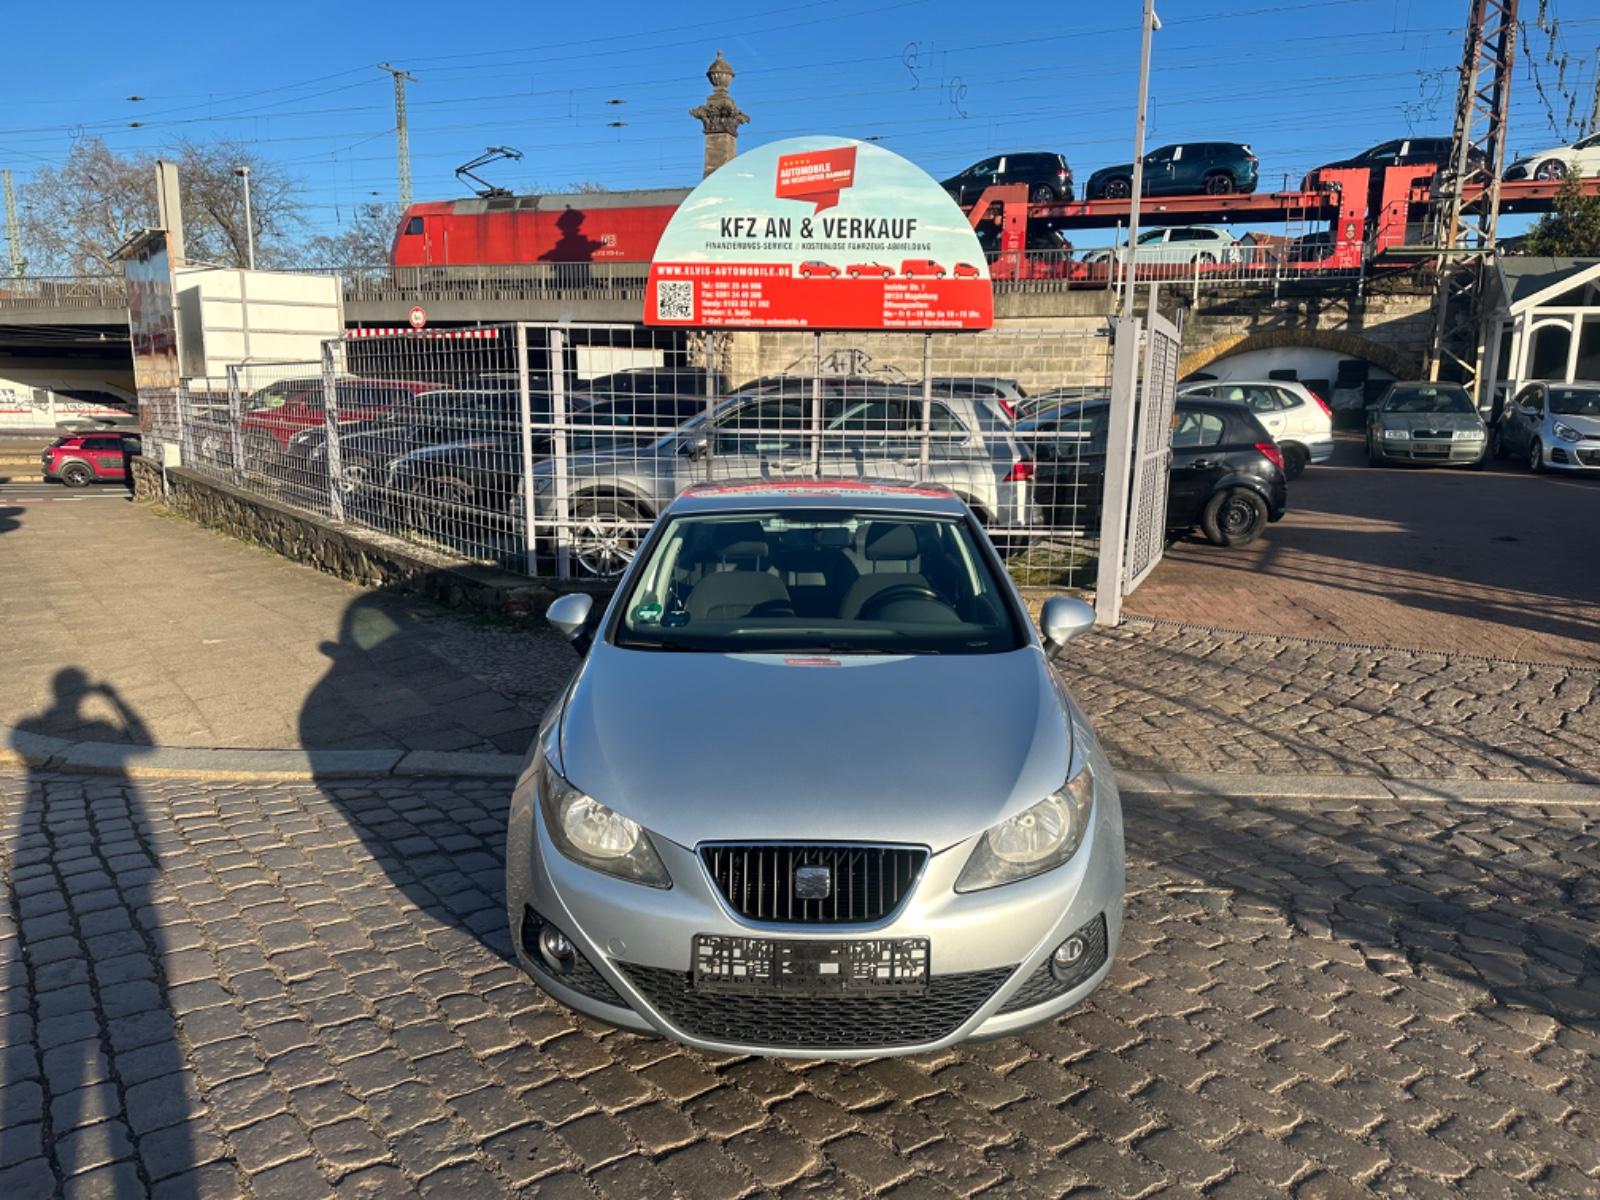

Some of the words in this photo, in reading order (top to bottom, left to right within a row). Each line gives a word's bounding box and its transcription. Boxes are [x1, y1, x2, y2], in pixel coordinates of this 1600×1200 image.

[780, 163, 831, 177] AUTOMOBILE
[720, 217, 757, 238] KFZ
[765, 217, 791, 238] AN
[800, 217, 814, 239] &
[823, 218, 917, 239] VERKAUF
[705, 242, 793, 250] FINANZIERUNGS-SERVICE
[801, 242, 846, 250] KOSTENLOSE
[848, 243, 931, 251] FAHRZEUG-ABMELDUNG
[657, 266, 790, 277] WWW.ELVIS-AUTOMOBILE.DE
[904, 293, 938, 302] Magdeburg
